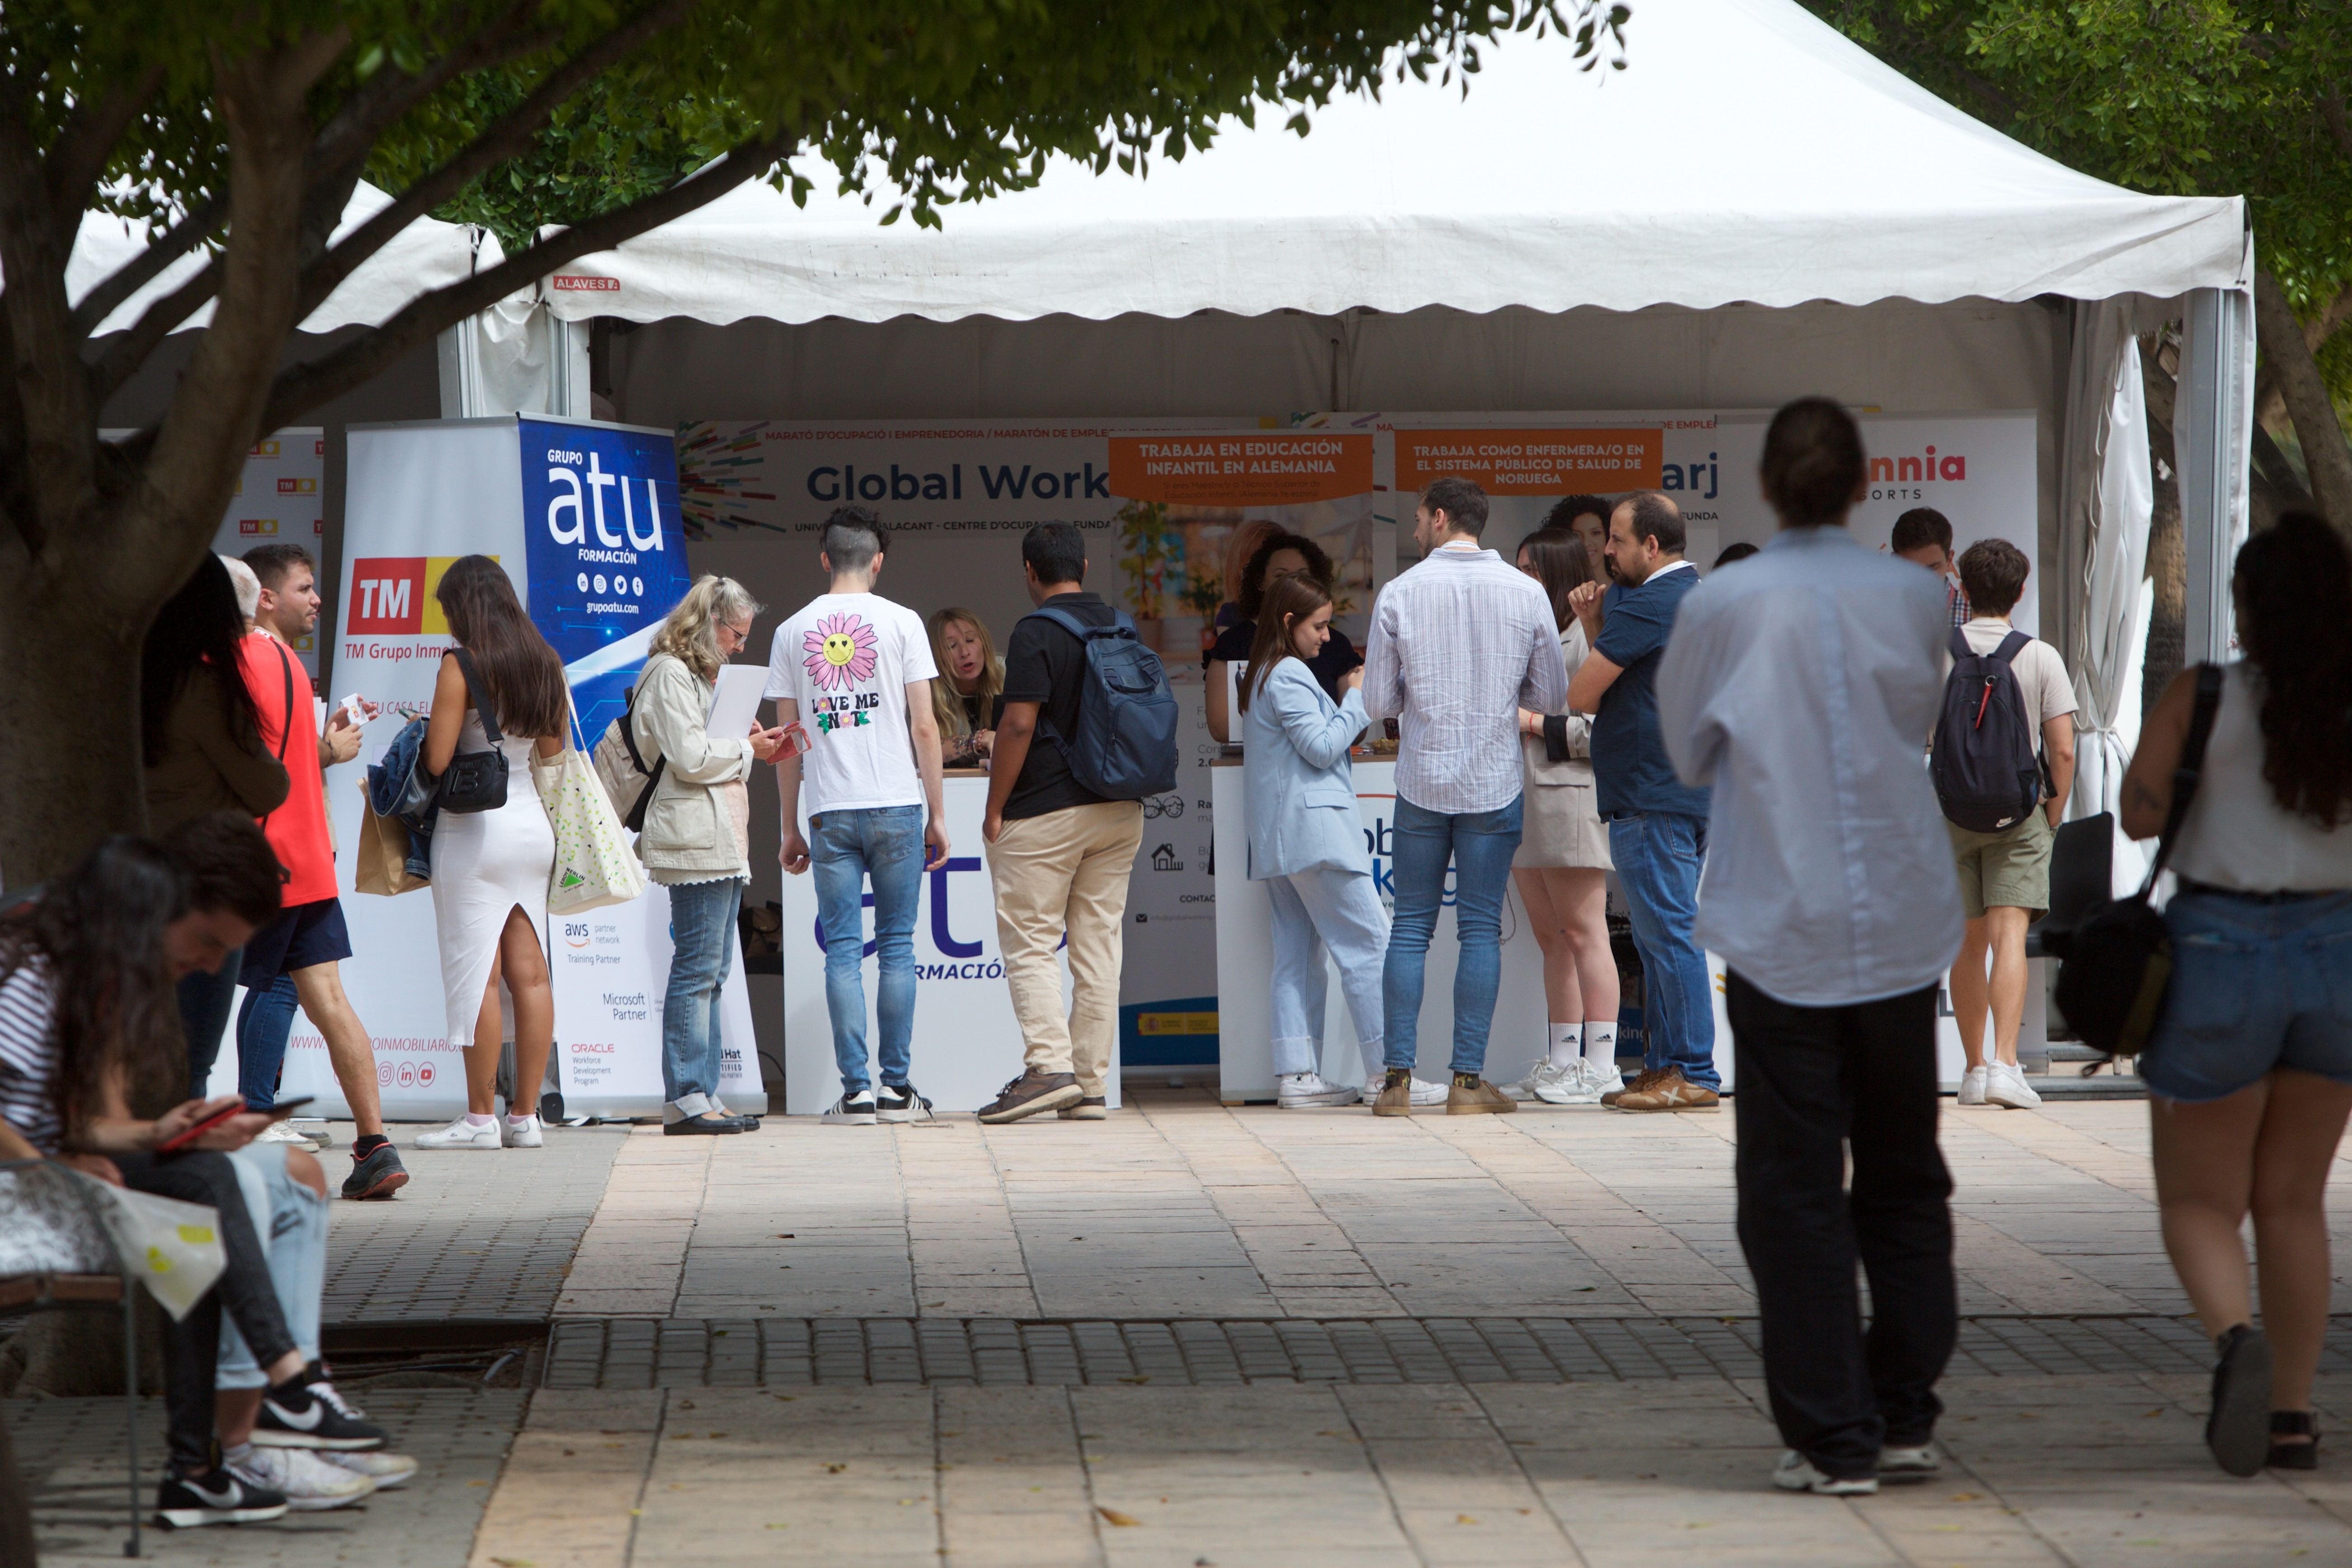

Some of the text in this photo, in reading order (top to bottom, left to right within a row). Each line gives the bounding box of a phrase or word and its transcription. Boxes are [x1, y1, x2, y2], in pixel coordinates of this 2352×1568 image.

[556, 278, 606, 289] ALAVES
[765, 429, 813, 440] MARATÓ
[895, 429, 985, 439] EMPRENEDORIA
[987, 428, 992, 438] /
[994, 427, 1049, 438] MARATÓN
[1053, 429, 1067, 437] DE
[1139, 438, 1343, 457] TRABAJA EN EDUCACIÓN
[1413, 444, 1644, 456] TRABAJA COMO ENFERMERA/O EN
[547, 449, 583, 465] GRUPO
[1417, 456, 1642, 470] EL SISTEMA PÚBLICO DE SALUD DE
[1147, 460, 1336, 475] INFANTIL EN ALEMANIA
[807, 462, 1110, 501] Global Work
[1495, 473, 1562, 484] NORUEGA
[279, 481, 294, 490] TM
[548, 451, 664, 552] atu
[242, 523, 255, 531] TM
[943, 521, 989, 530] CENTRE
[578, 548, 637, 564] FORMACIÓN
[359, 579, 411, 619] TM
[586, 601, 639, 615] grupoatu.com
[345, 643, 365, 659] TM
[369, 643, 412, 663] Grupo
[855, 692, 879, 709] ME
[566, 867, 586, 881] MERLIN
[565, 923, 616, 937] aws partner
[596, 935, 620, 944] network
[568, 953, 621, 966] Training Partner
[603, 992, 646, 1005] Microsoft
[613, 1008, 647, 1020] Partner
[571, 1043, 615, 1053] ORACLE
[724, 1049, 742, 1059] Hat
[572, 1056, 601, 1064] Workforce
[573, 1066, 611, 1076] Development
[574, 1076, 599, 1086] Program
